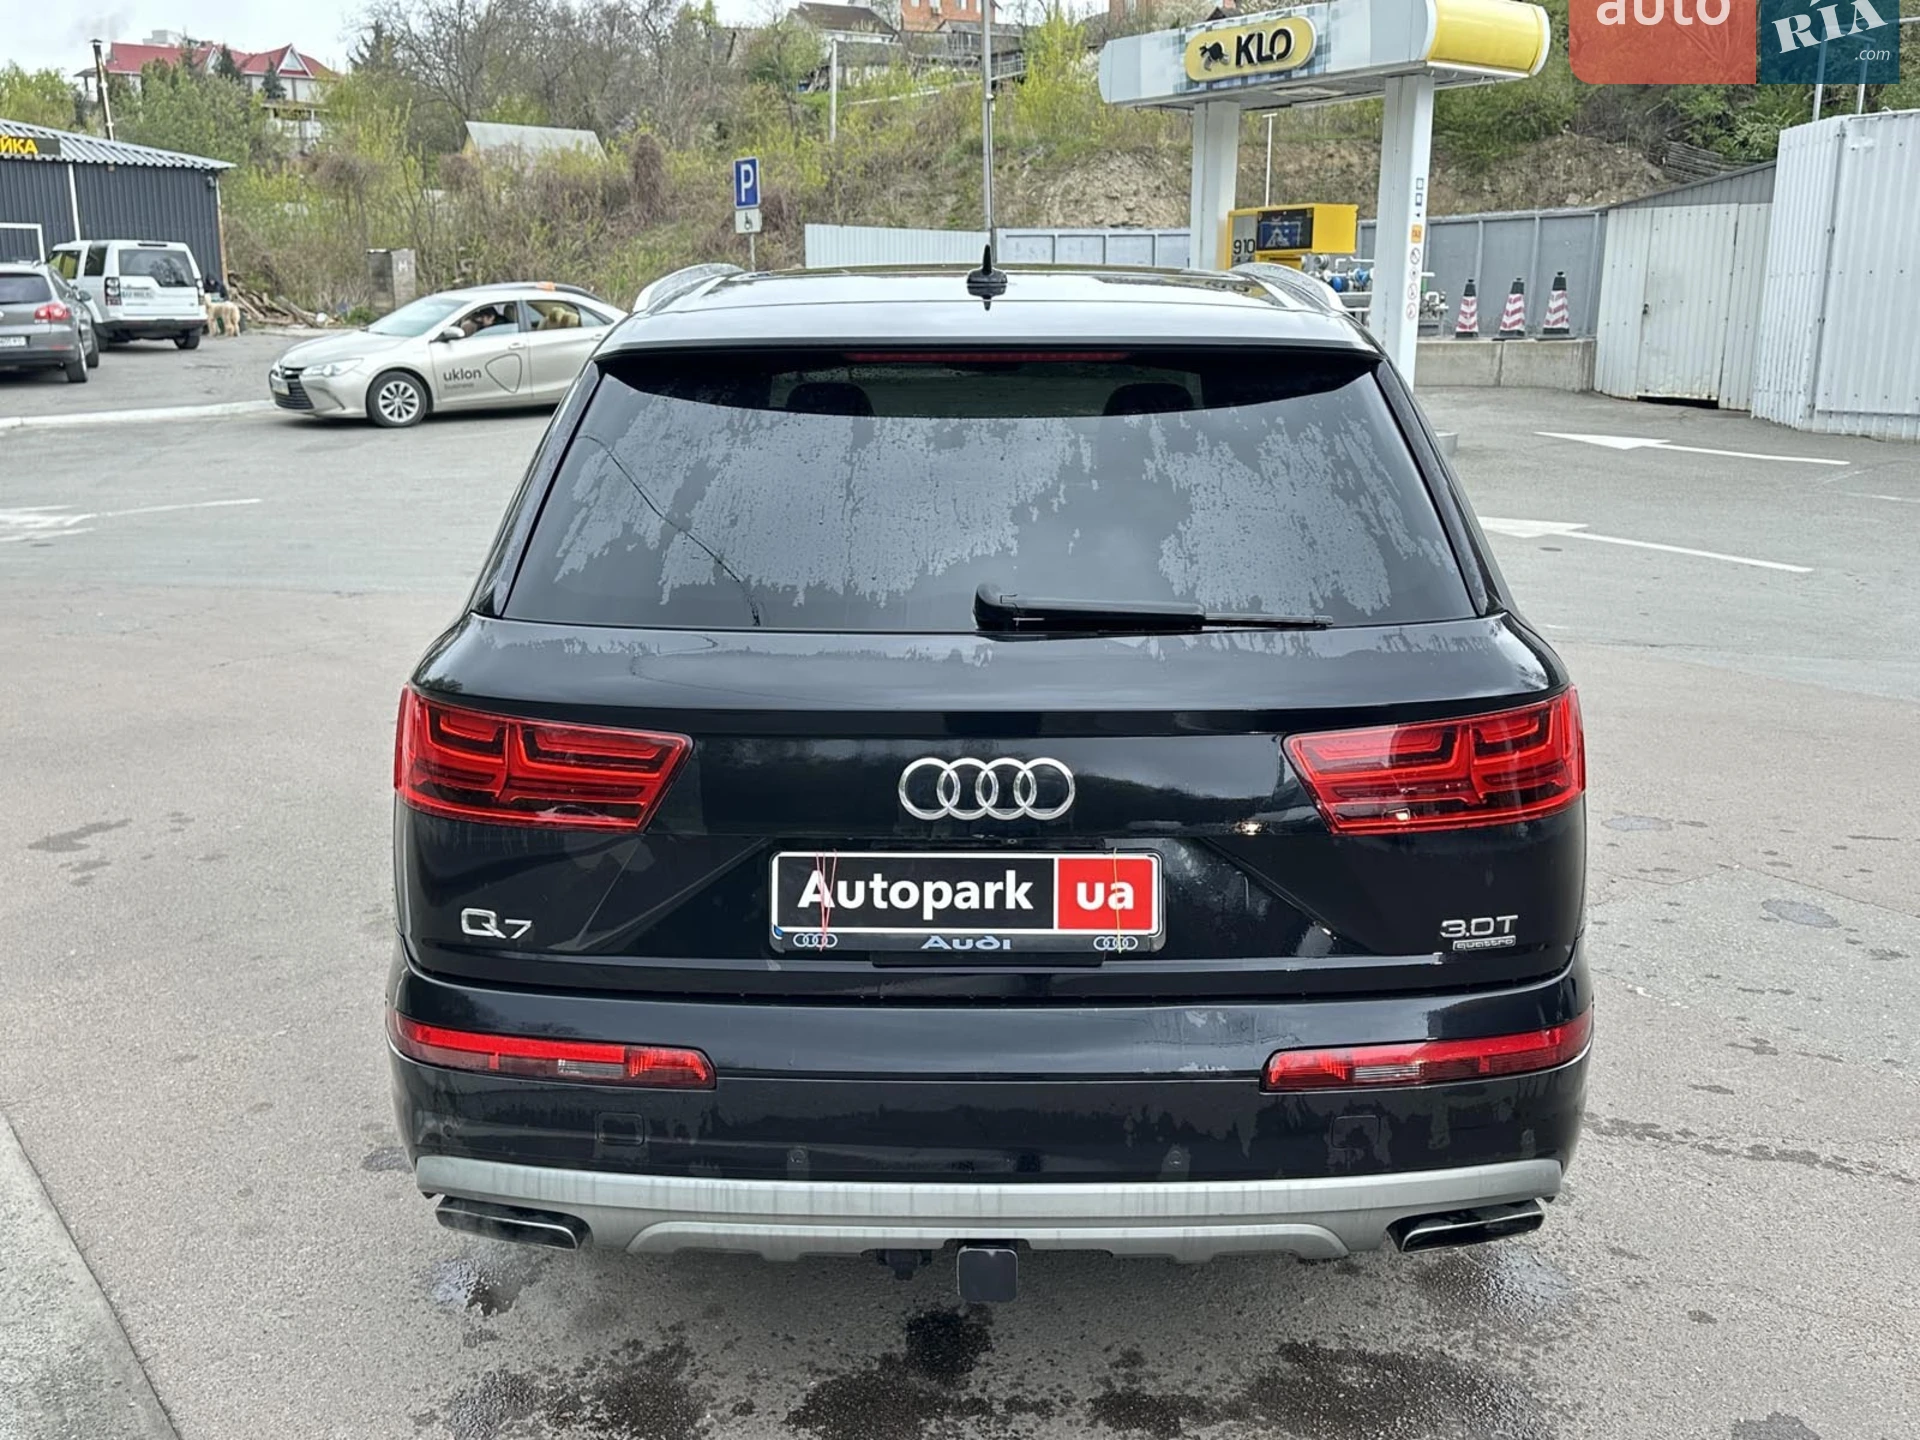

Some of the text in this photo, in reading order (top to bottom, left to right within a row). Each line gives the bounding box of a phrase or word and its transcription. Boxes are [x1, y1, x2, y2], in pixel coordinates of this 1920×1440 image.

[1236, 28, 1293, 66] KLO
[740, 163, 754, 203] P
[443, 368, 481, 381] uklon
[797, 869, 1135, 921] Autopark ua
[461, 907, 532, 939] Q7
[1456, 939, 1514, 951] quattro
